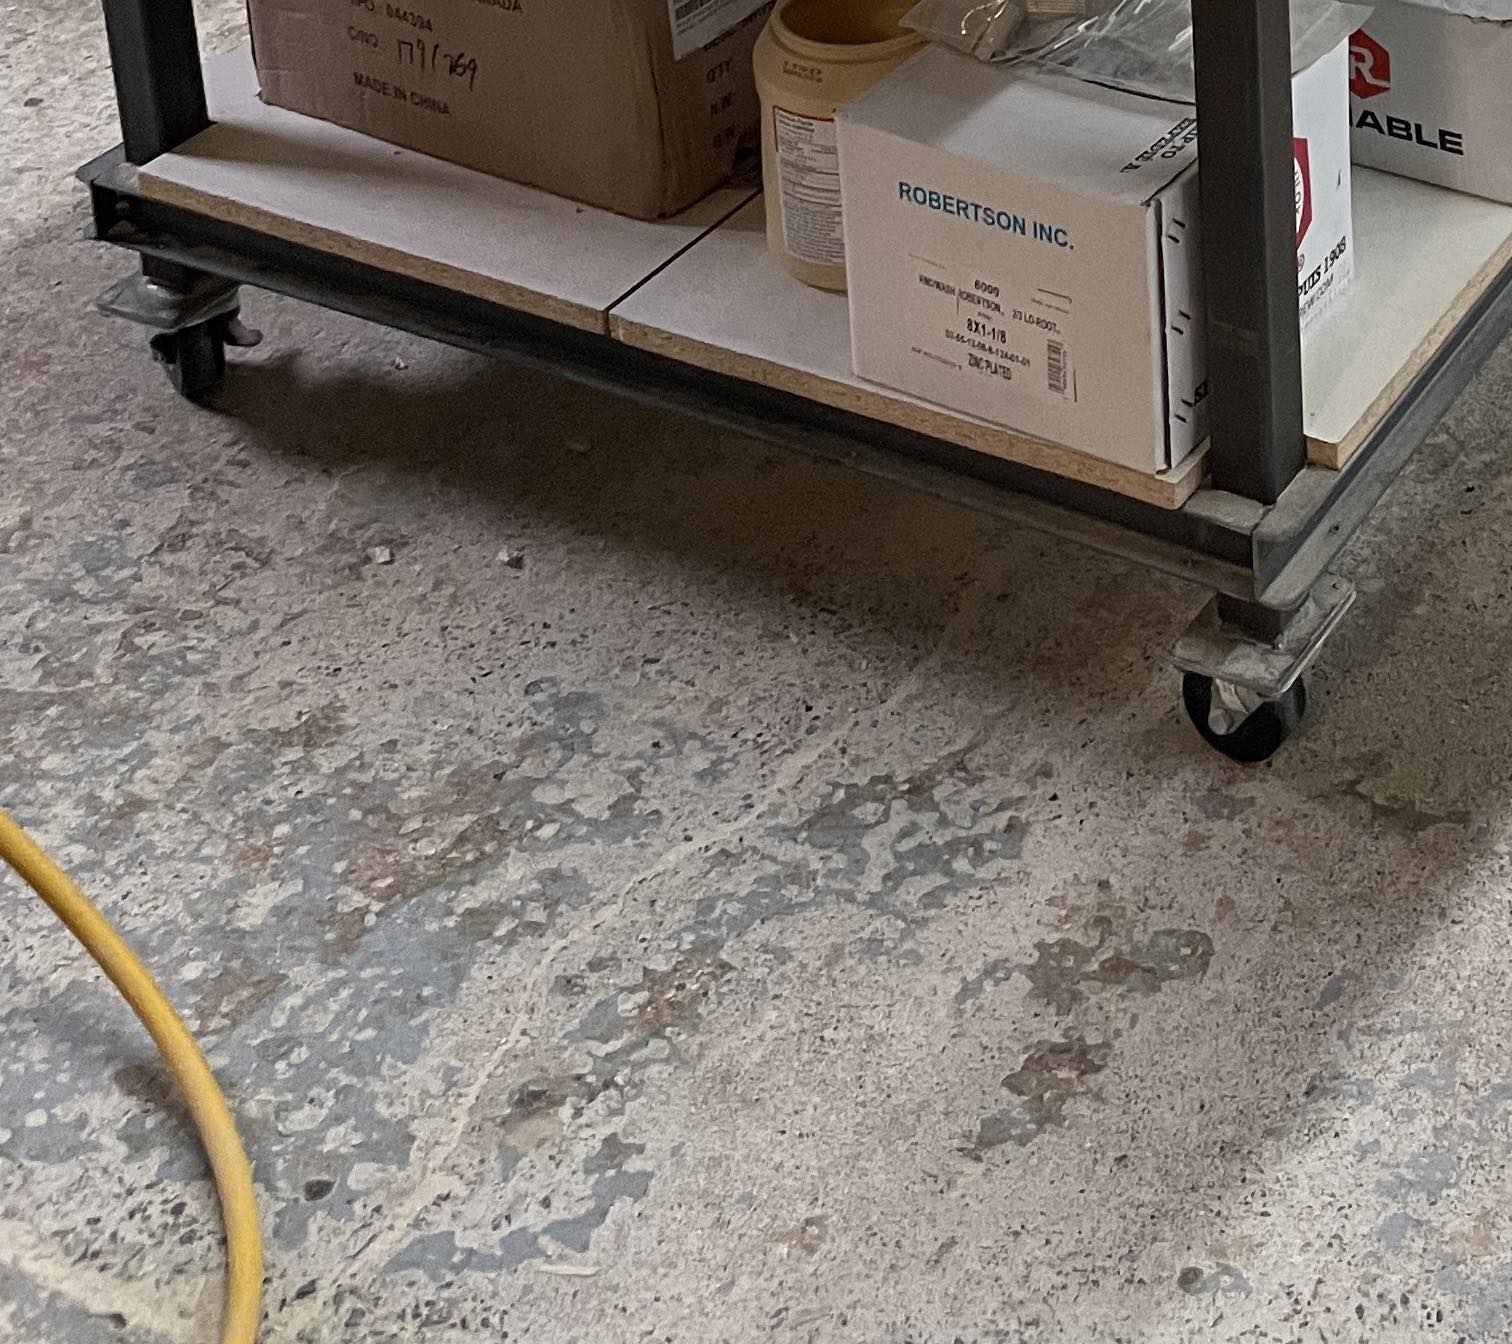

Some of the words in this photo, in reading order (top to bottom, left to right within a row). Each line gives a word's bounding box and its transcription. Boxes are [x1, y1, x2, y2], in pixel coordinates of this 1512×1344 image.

[354, 71, 392, 97] MADE
[391, 85, 408, 103] IN
[410, 91, 451, 115] CHINA
[898, 180, 1027, 237] ROBERTSON
[1032, 220, 1075, 250] INC.
